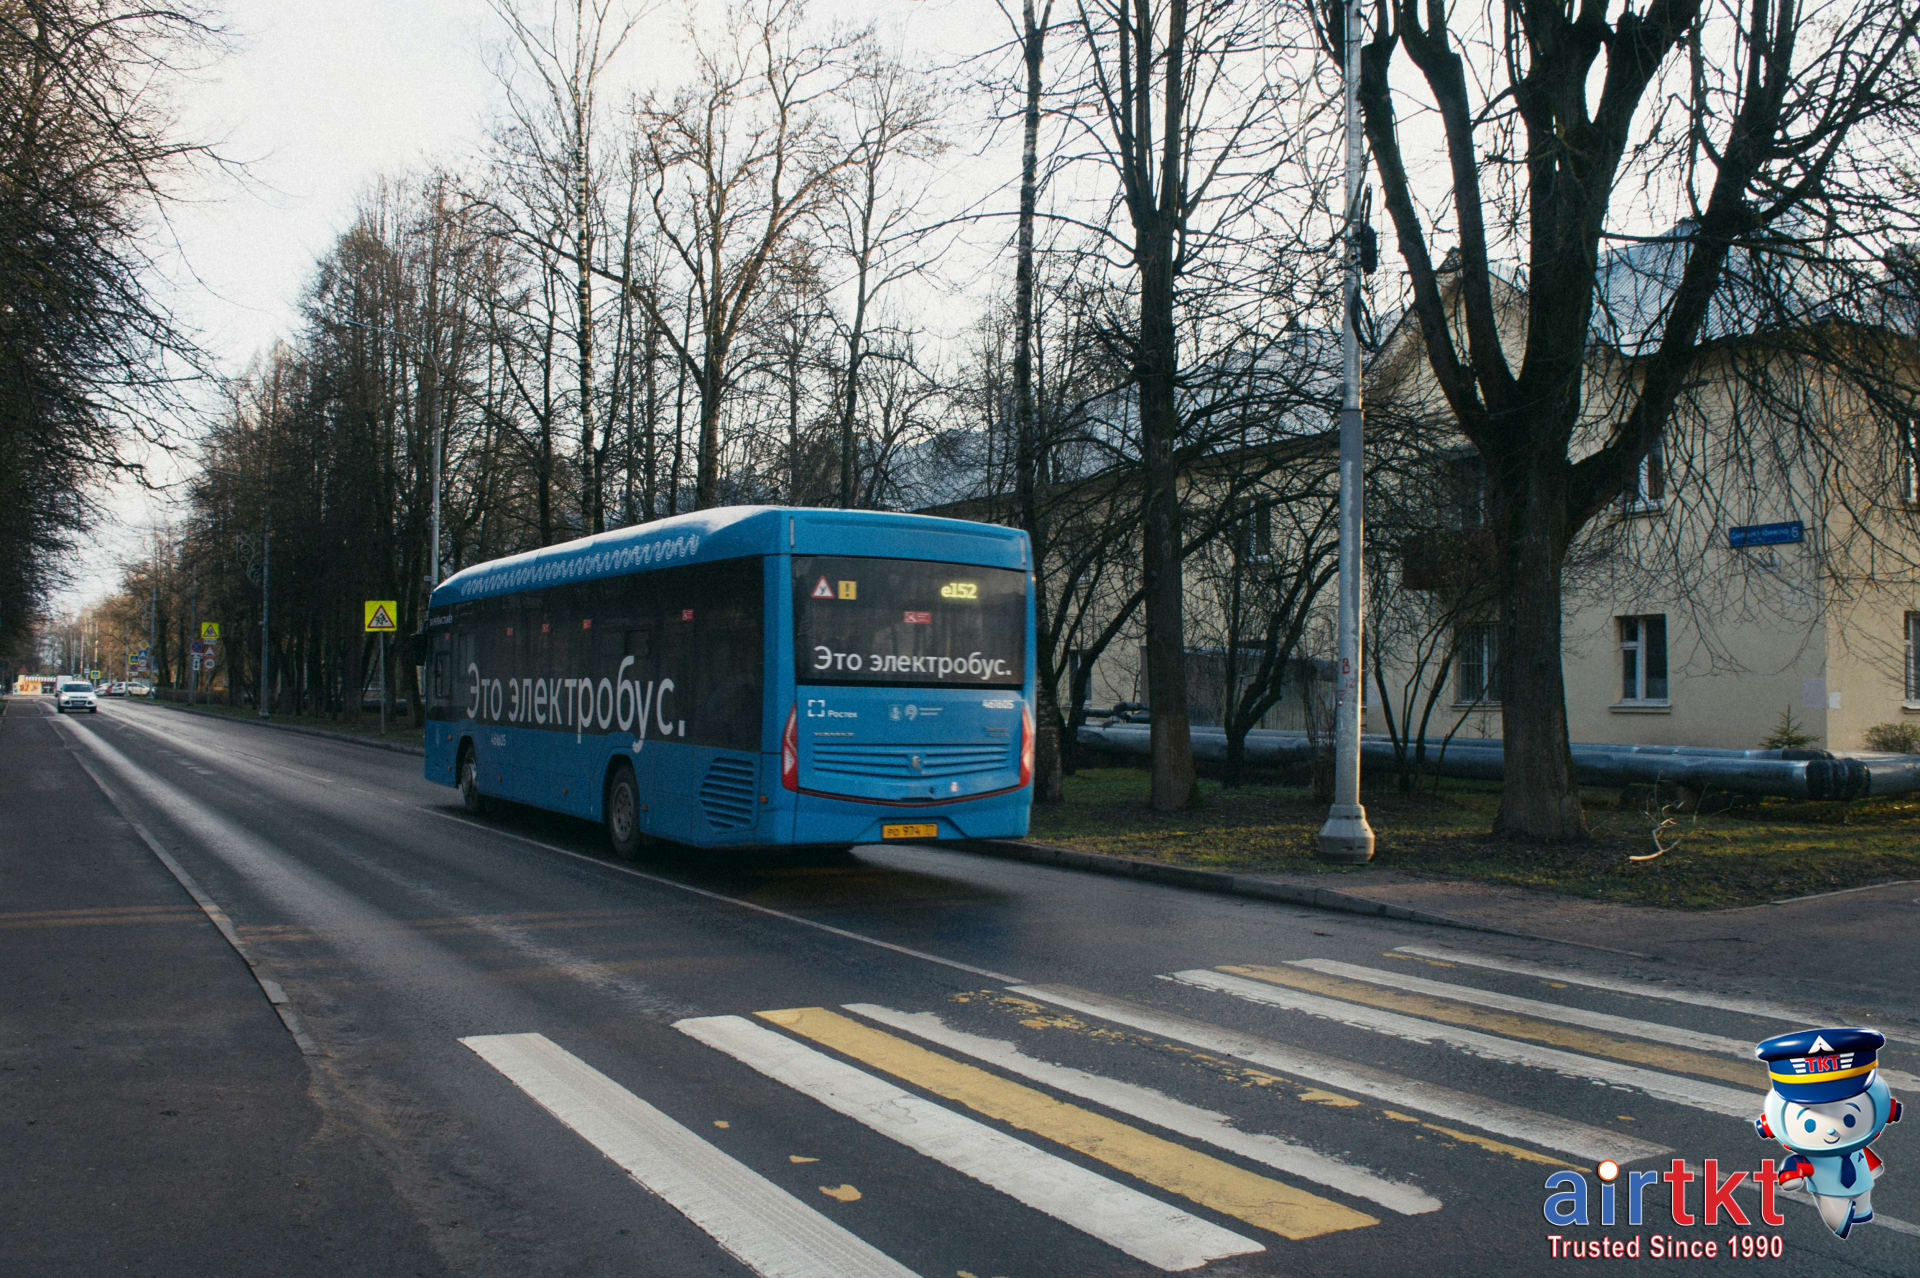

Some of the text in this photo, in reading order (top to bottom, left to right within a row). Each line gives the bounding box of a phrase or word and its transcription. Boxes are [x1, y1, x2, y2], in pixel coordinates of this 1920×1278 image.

[813, 645, 1012, 680] Это электробус.
[466, 655, 686, 753] Это электробус.
